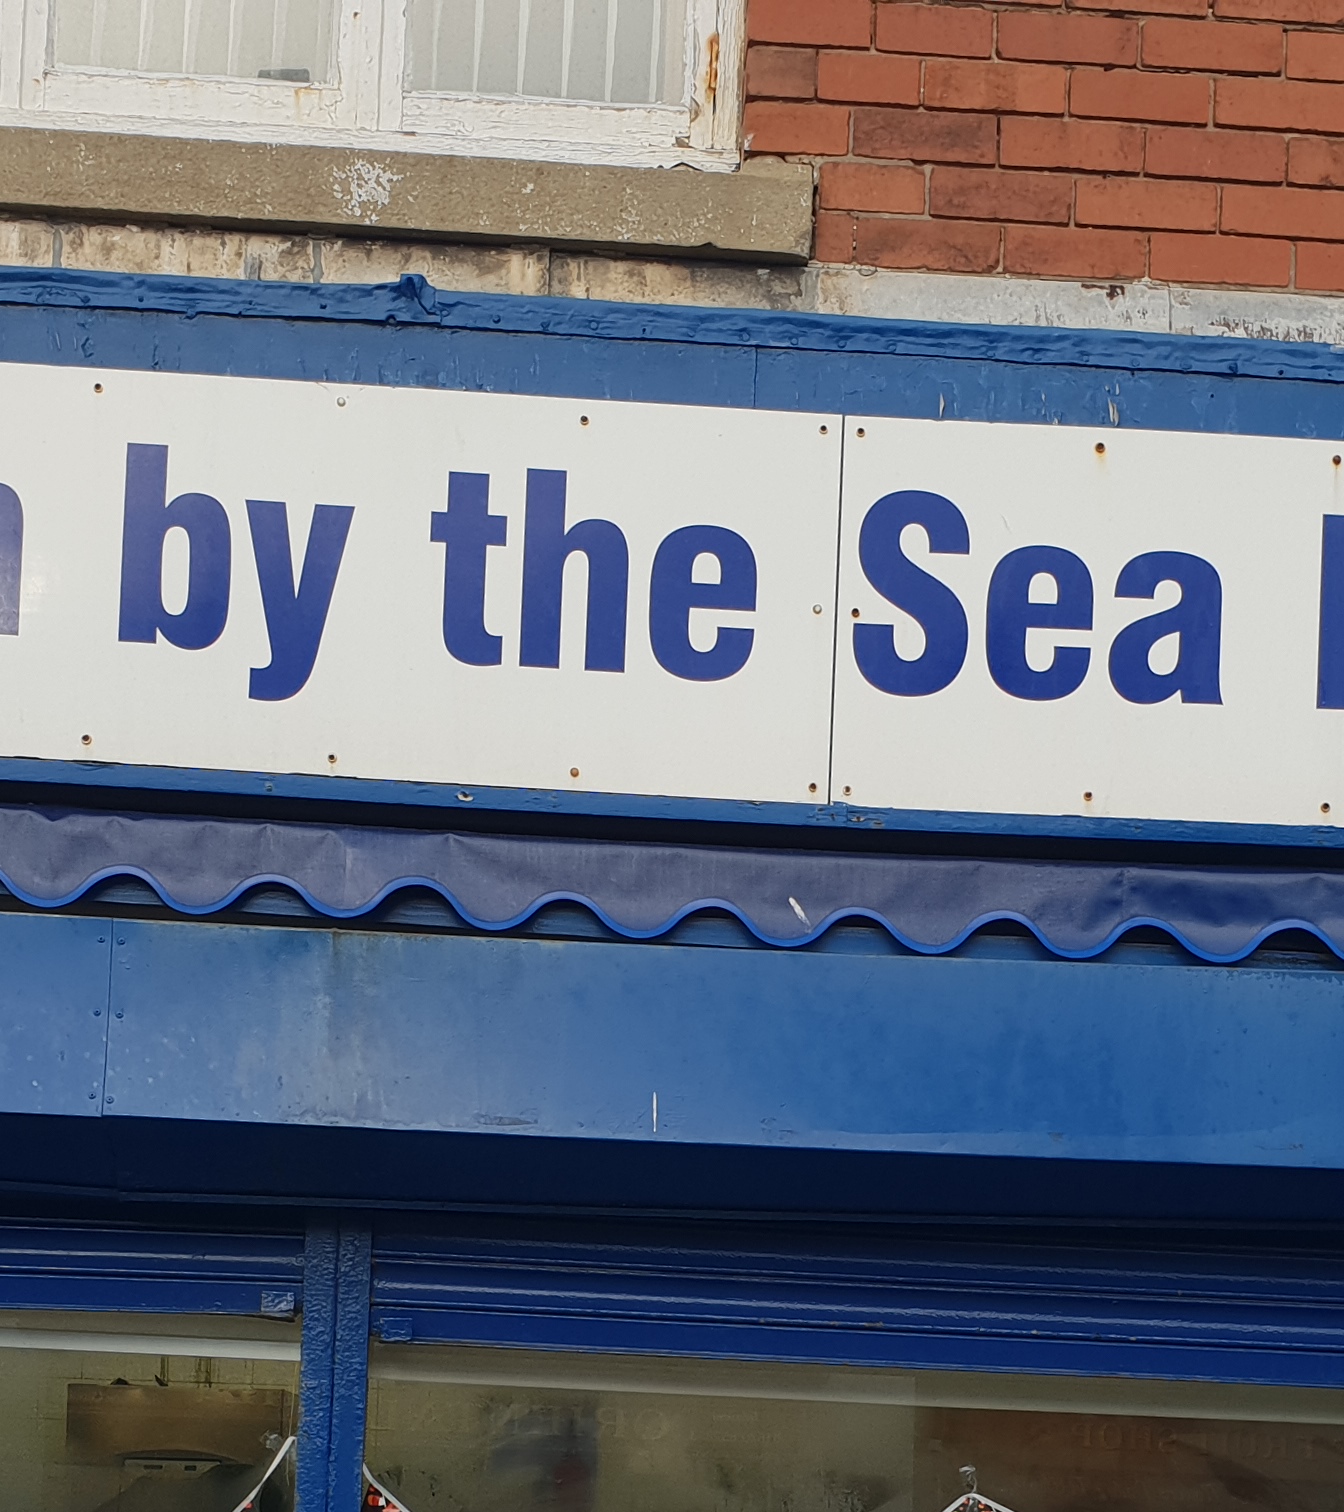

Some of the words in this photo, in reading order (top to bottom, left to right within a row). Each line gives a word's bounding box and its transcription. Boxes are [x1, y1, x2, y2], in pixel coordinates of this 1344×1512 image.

[118, 443, 354, 701] by
[430, 468, 757, 682] the
[852, 490, 1224, 706] Sea
